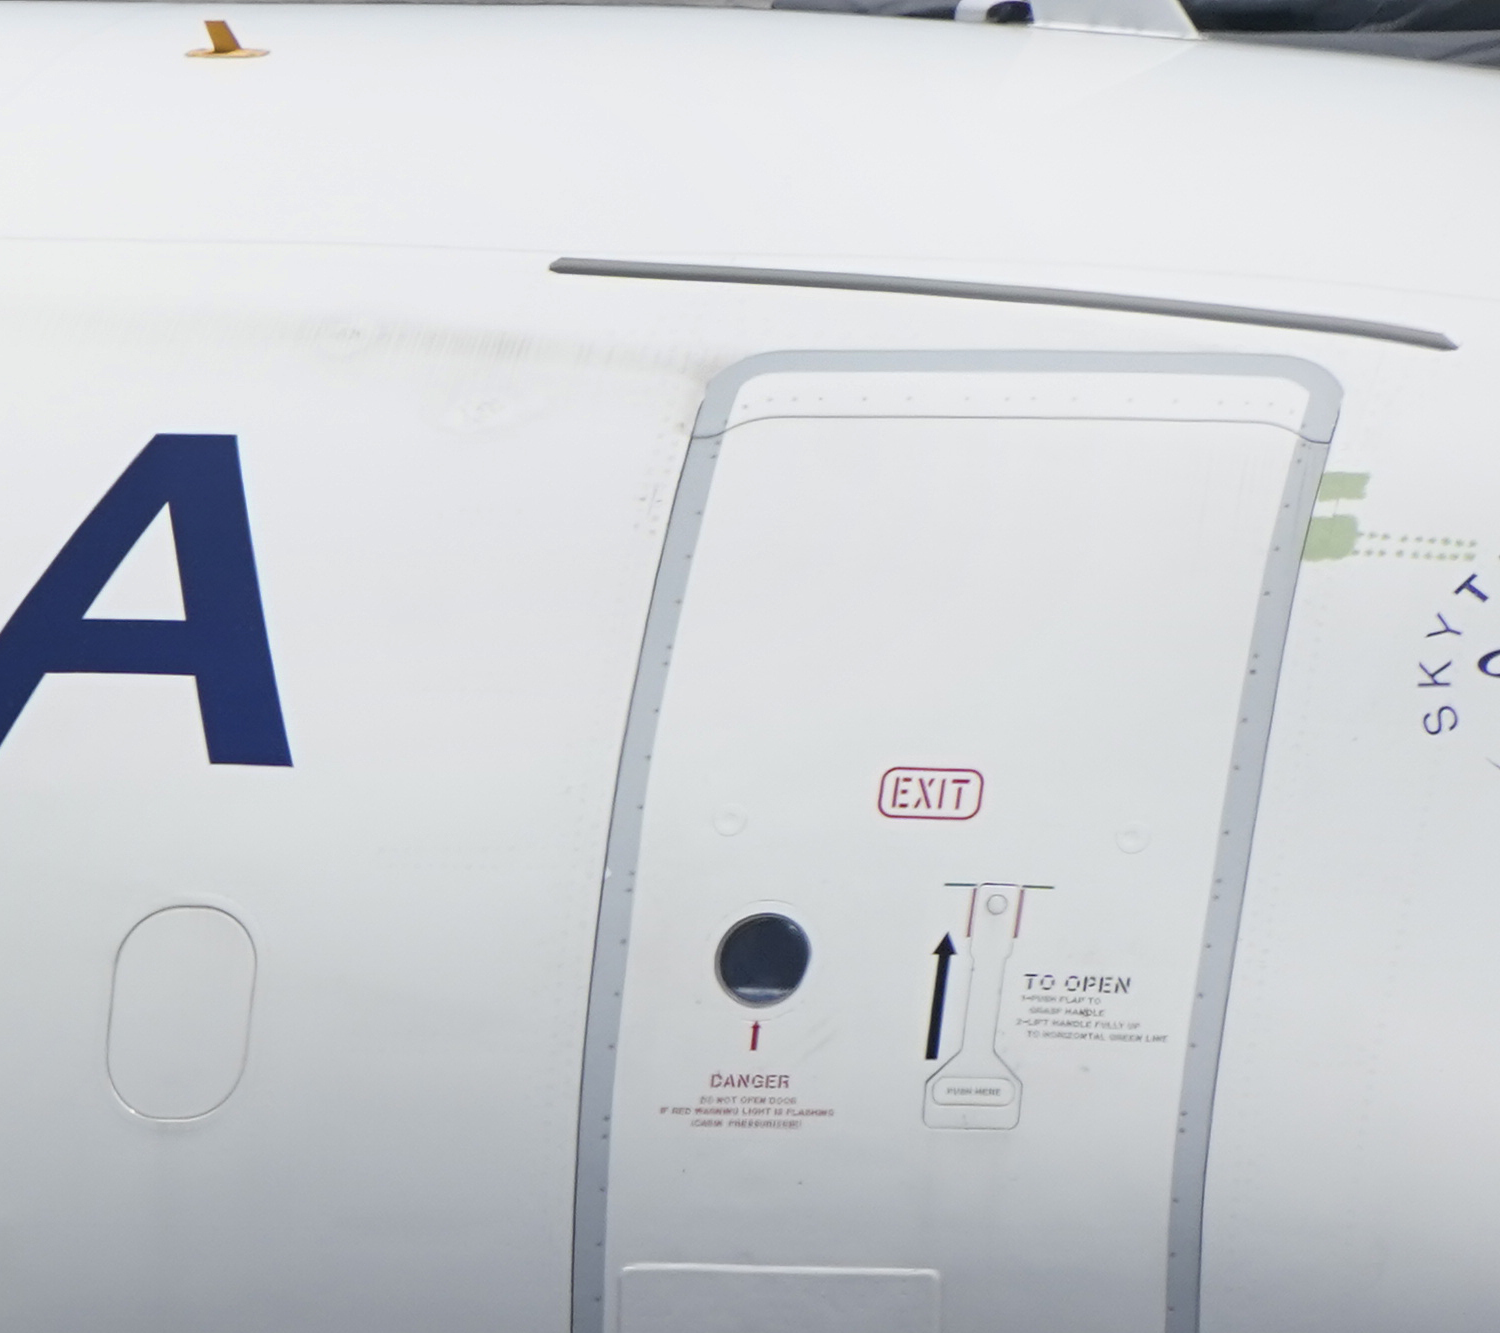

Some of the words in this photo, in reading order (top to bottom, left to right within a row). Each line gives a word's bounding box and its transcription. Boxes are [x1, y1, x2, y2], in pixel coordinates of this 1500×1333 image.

[891, 777, 971, 810] EXIT
[1023, 973, 1056, 991] TO
[1064, 975, 1132, 994] OPEN
[1064, 1008, 1106, 1017] HANDLE
[1052, 1019, 1092, 1029] HANDLE
[1094, 1020, 1124, 1030] FULLY
[1027, 1030, 1040, 1039] TO
[710, 1073, 790, 1089] DANGER
[974, 1087, 1001, 1096] HERE
[716, 1096, 738, 1105] NOT
[740, 1096, 766, 1105] OPEN
[671, 1107, 691, 1116] RED
